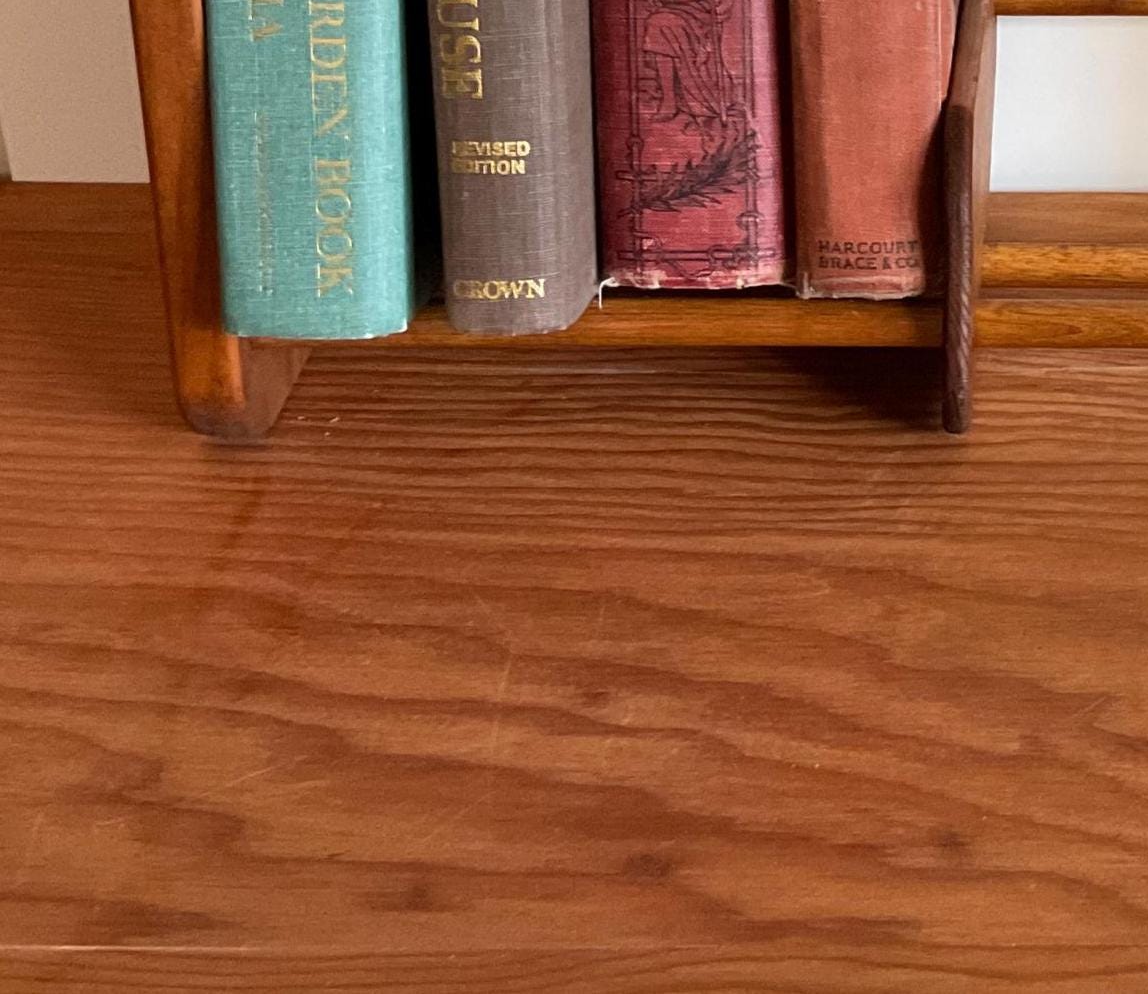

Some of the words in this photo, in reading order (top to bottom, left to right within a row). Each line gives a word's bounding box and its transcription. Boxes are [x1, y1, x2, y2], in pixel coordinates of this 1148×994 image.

[451, 140, 531, 157] REVISED
[451, 159, 526, 175] EDITION
[314, 157, 354, 299] BOOK
[817, 239, 918, 255] HARCOURT
[818, 256, 877, 270] BRACE
[882, 256, 892, 270] &
[453, 278, 546, 299] CROWN
